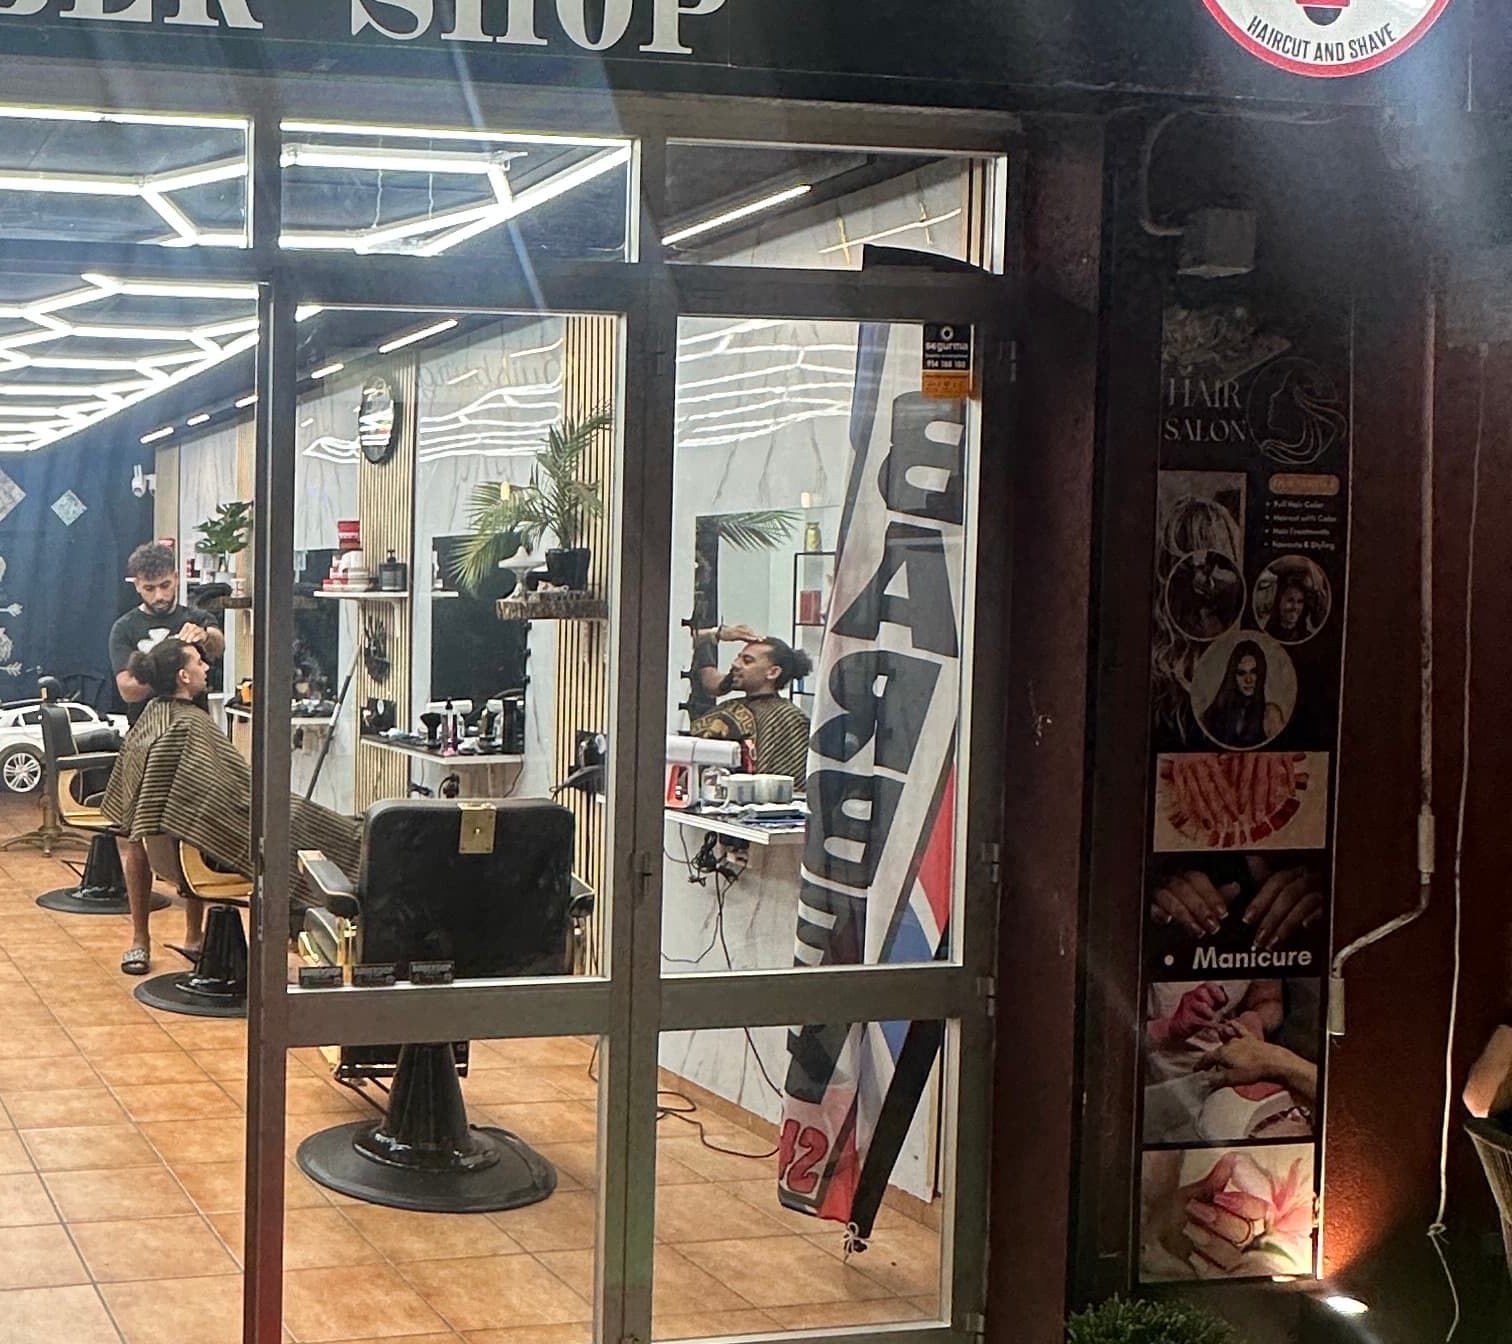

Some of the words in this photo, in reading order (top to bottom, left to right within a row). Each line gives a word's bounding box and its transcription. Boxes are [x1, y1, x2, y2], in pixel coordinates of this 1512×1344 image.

[1246, 15, 1312, 60] HAIRCUT
[1312, 41, 1346, 63] AND
[1348, 21, 1397, 60] SHAVE
[1168, 377, 1242, 409] HAIR
[1163, 417, 1248, 442] SALON
[1191, 945, 1313, 970] Manicure
